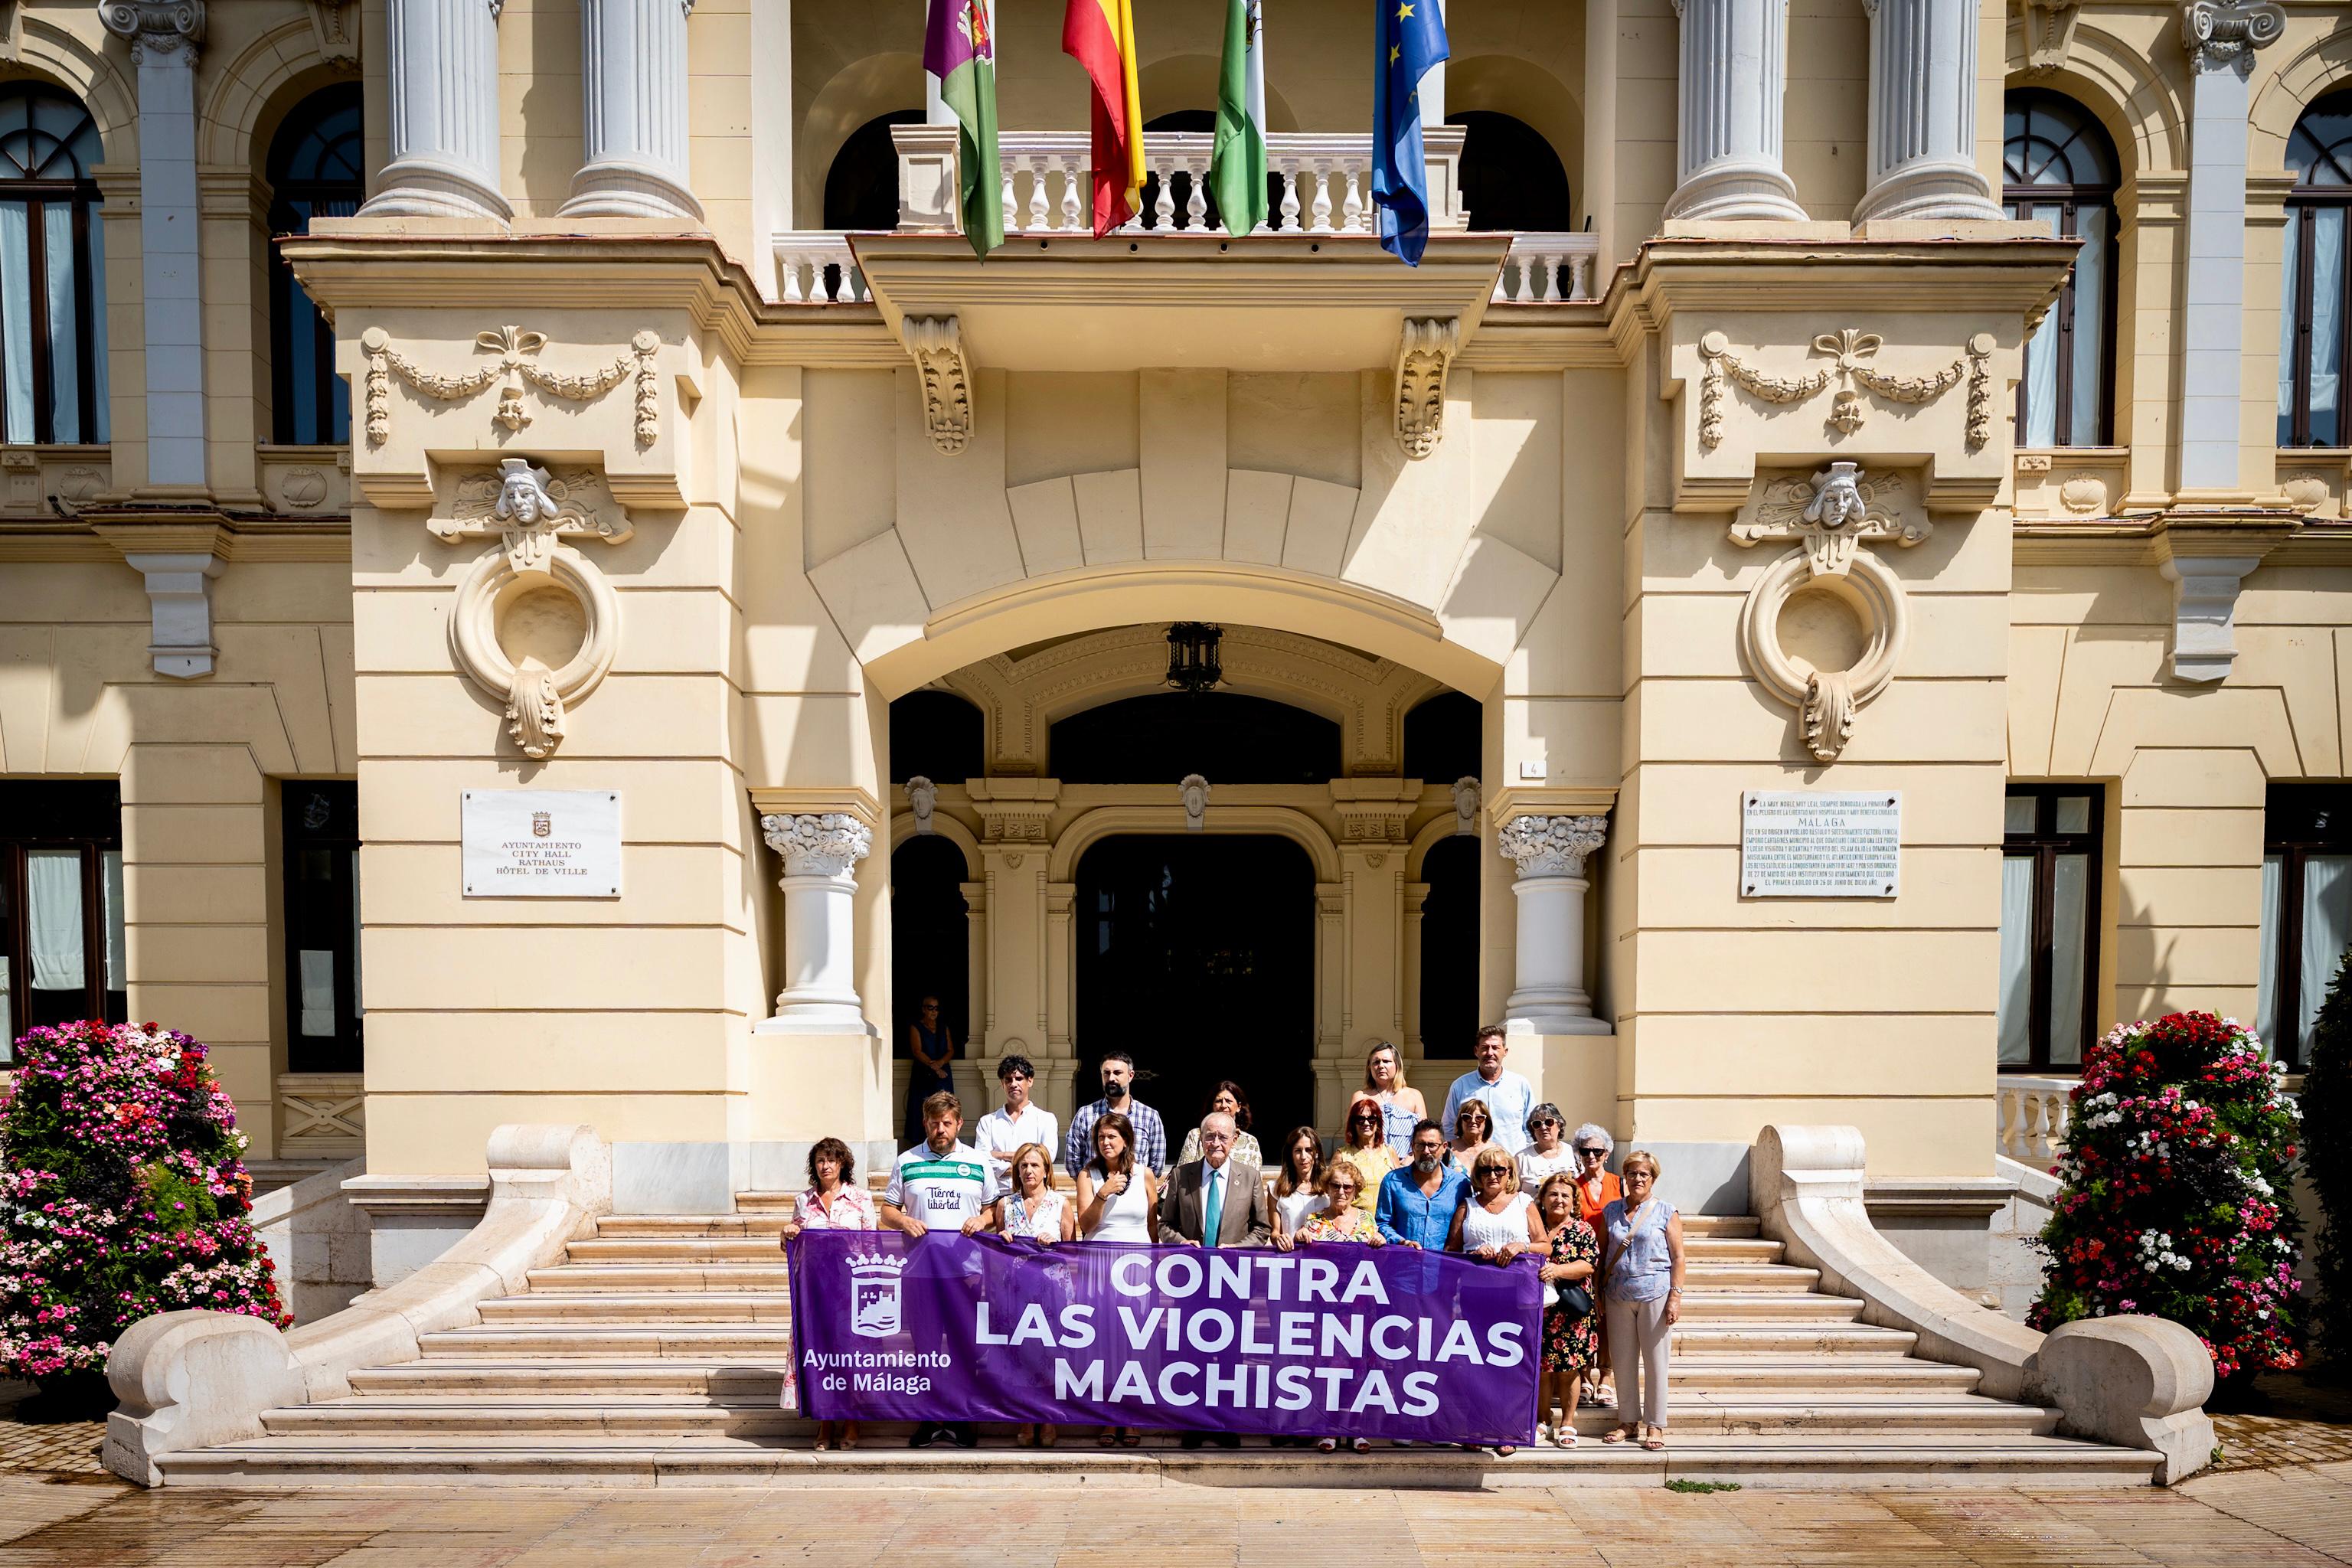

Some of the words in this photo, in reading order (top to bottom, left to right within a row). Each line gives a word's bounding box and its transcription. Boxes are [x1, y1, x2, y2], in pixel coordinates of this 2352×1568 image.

[1531, 764, 1537, 775] 4
[497, 866, 530, 875] HÔTEL
[1110, 1253, 1390, 1305] CONTRA
[976, 1301, 1096, 1349] LAS
[1116, 1305, 1524, 1368] VIOLENCIAS
[803, 1348, 952, 1372] Ayuntamiento
[822, 1373, 846, 1391] de
[853, 1372, 933, 1396] Málaga
[1055, 1357, 1440, 1416] MACHISTAS
